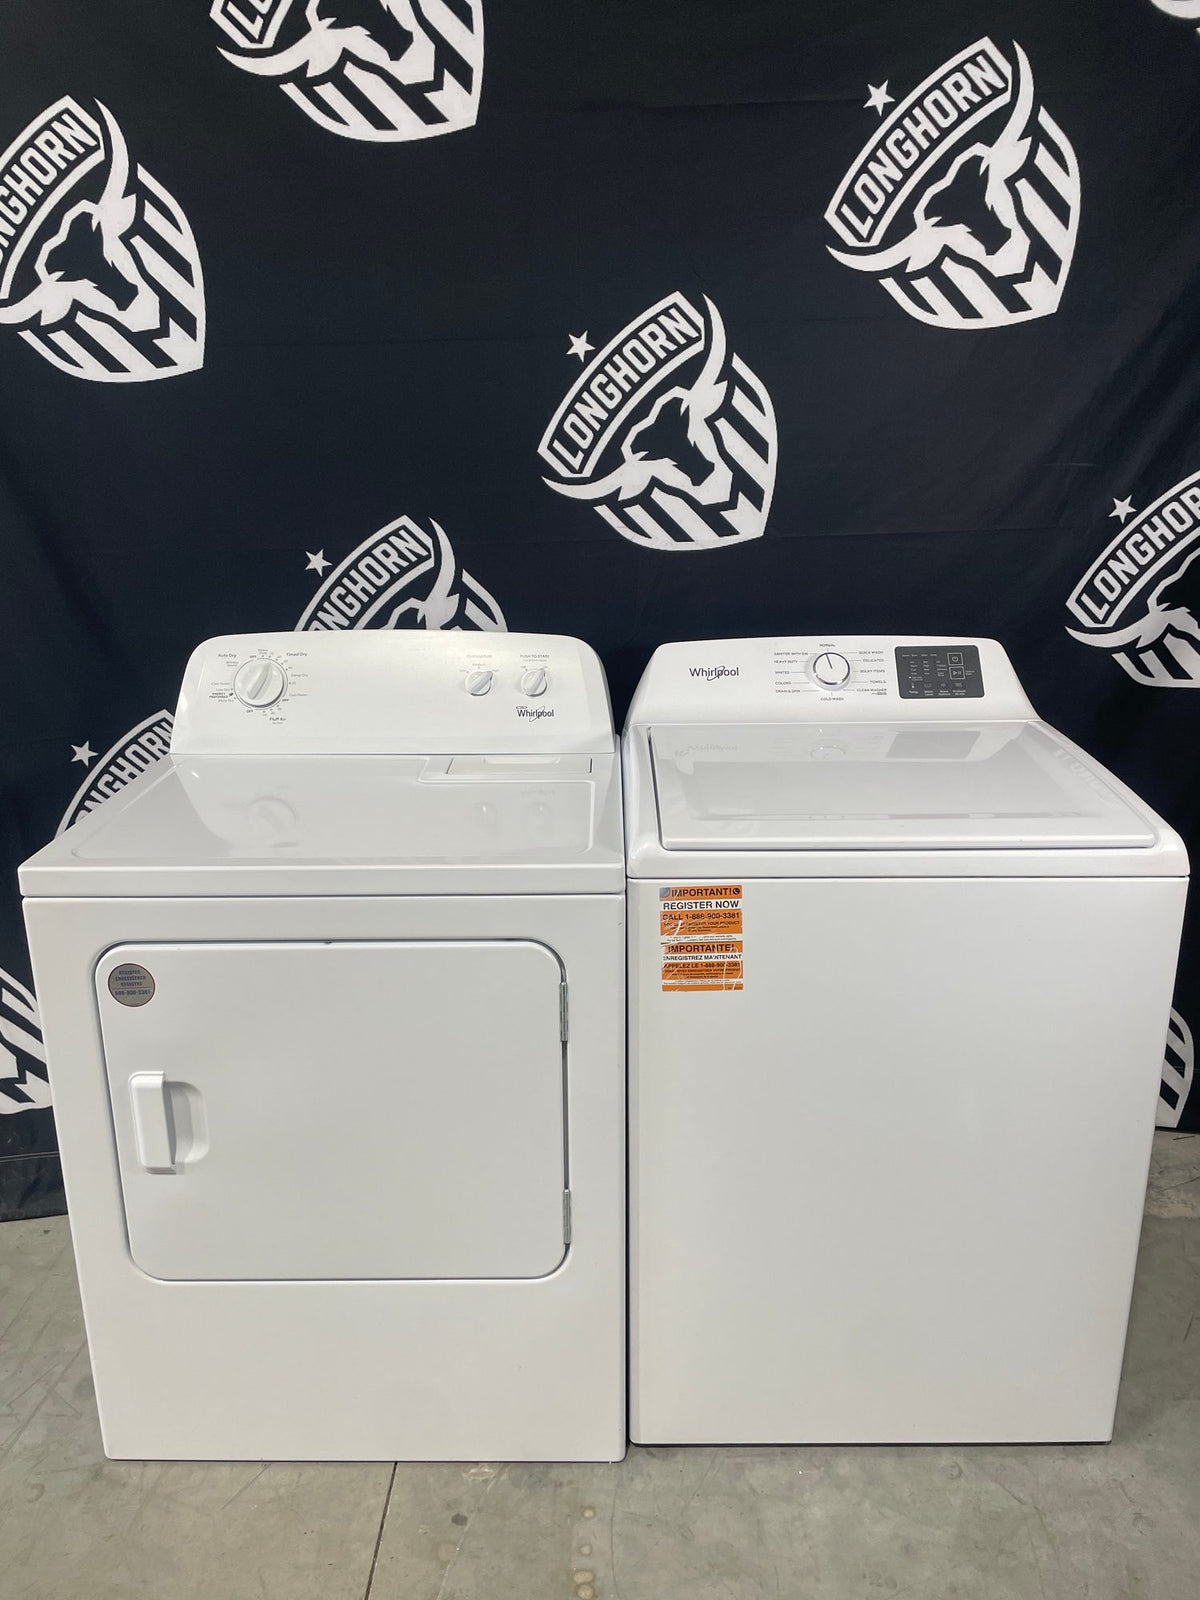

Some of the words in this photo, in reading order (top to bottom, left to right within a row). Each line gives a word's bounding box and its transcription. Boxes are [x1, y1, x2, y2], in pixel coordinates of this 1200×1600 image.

[839, 54, 1005, 237] LONGHORN
[552, 304, 700, 469] LONGHORN
[689, 666, 740, 680] Whirlpool
[516, 707, 555, 721] Whirlpool
[671, 888, 732, 897] IMPORTANT!
[663, 901, 713, 910] REGISTER
[715, 900, 739, 909] NOW
[662, 913, 684, 921] CALL
